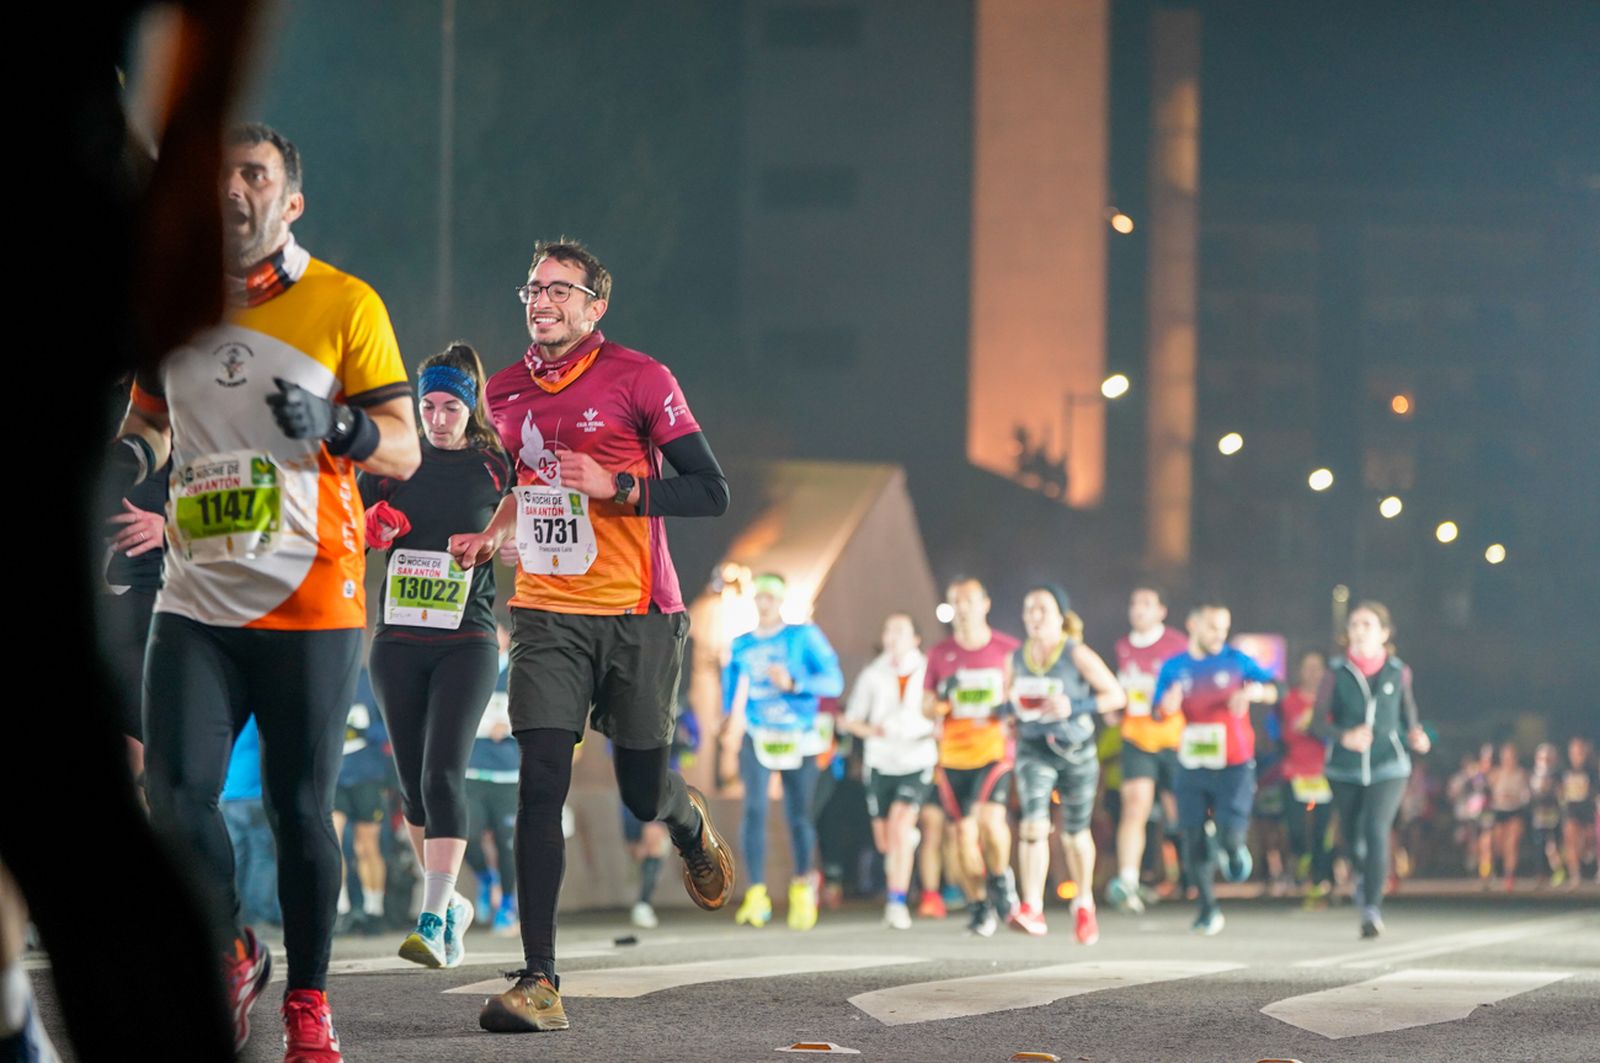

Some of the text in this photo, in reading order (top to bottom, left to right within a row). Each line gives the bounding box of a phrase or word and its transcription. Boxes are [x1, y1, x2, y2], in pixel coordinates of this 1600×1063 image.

[228, 463, 240, 475] DE
[538, 456, 557, 480] 43
[197, 488, 256, 526] 1147
[532, 496, 551, 505] NOCHE
[552, 496, 562, 505] DE
[525, 506, 537, 515] SAN
[533, 517, 578, 544] 5731
[397, 567, 413, 576] SAN
[398, 577, 460, 603] 13022
